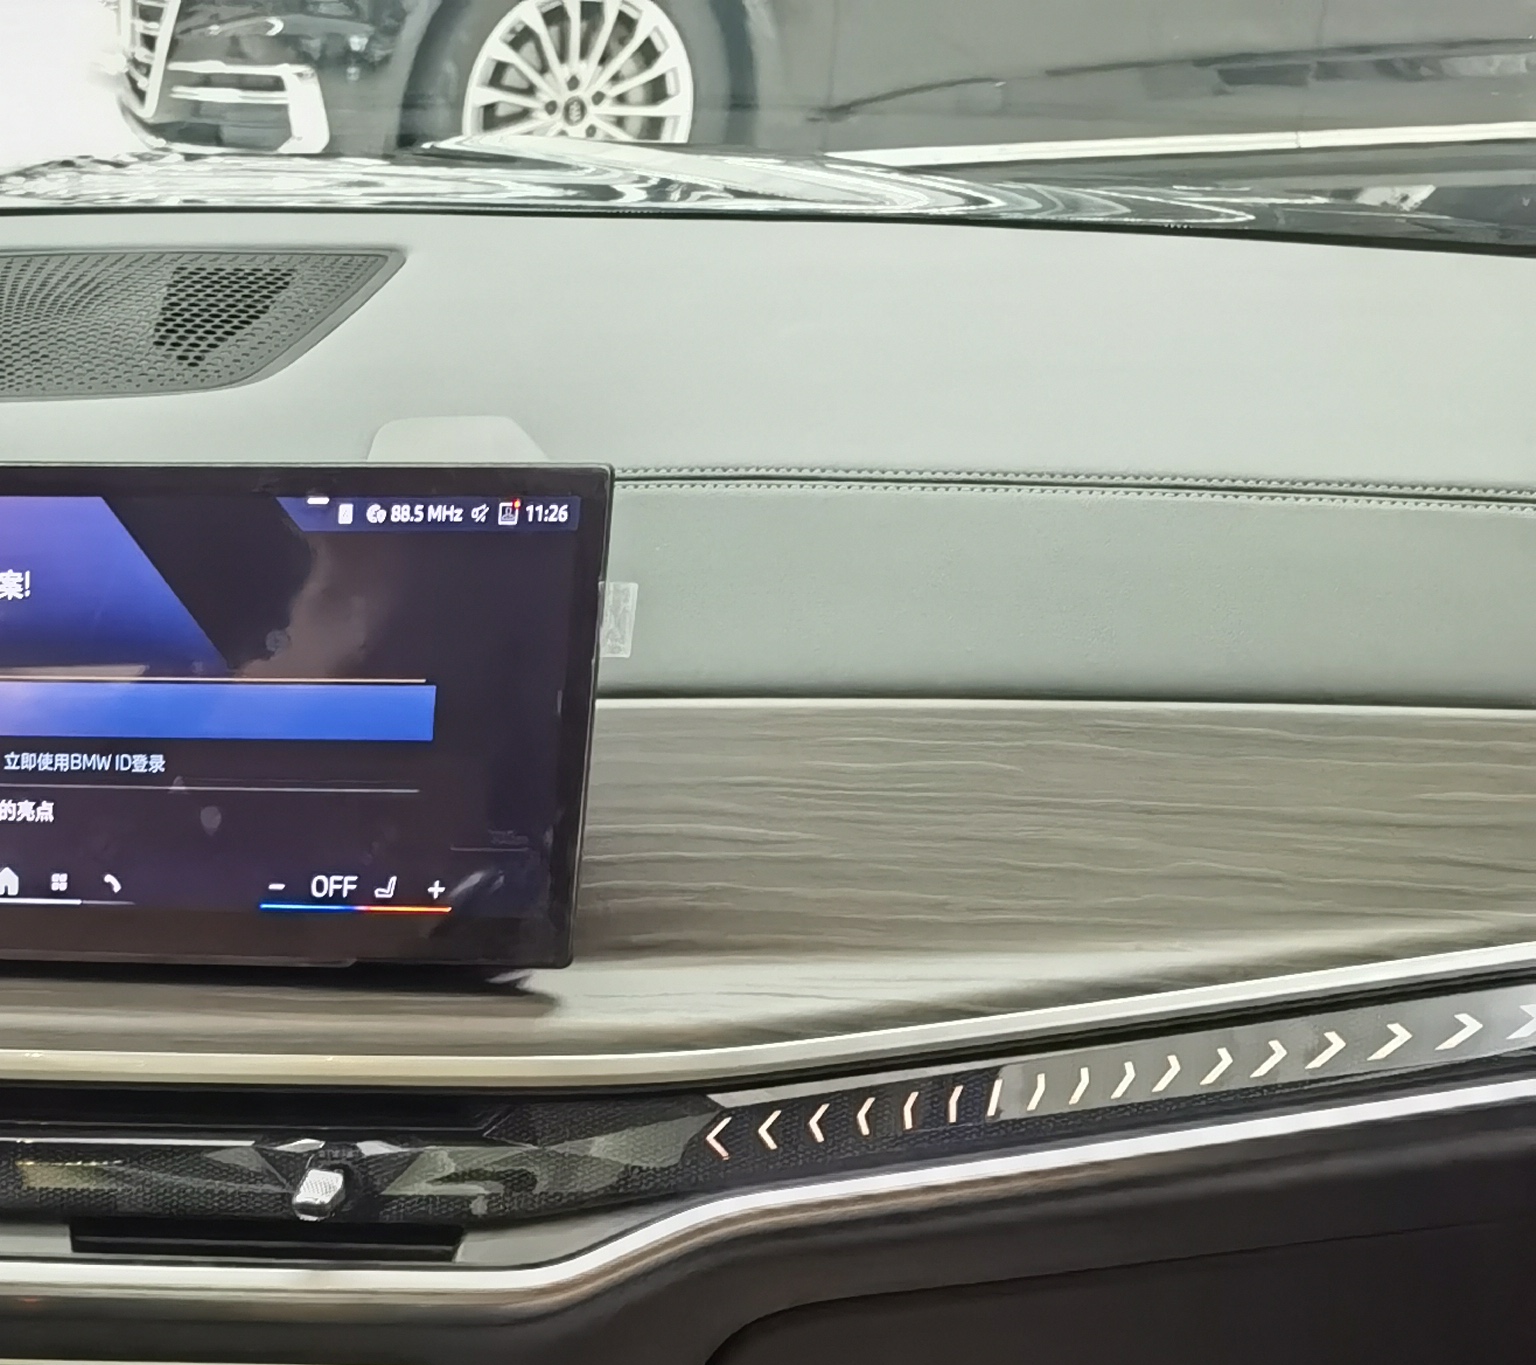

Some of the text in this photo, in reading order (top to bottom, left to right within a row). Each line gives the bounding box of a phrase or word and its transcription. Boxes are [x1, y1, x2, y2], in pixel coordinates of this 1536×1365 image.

[390, 503, 464, 523] 88.5 MHz
[525, 504, 569, 523] 11:26
[3, 752, 166, 774] 立即使用BMW ID登录
[311, 874, 359, 899] OFF
